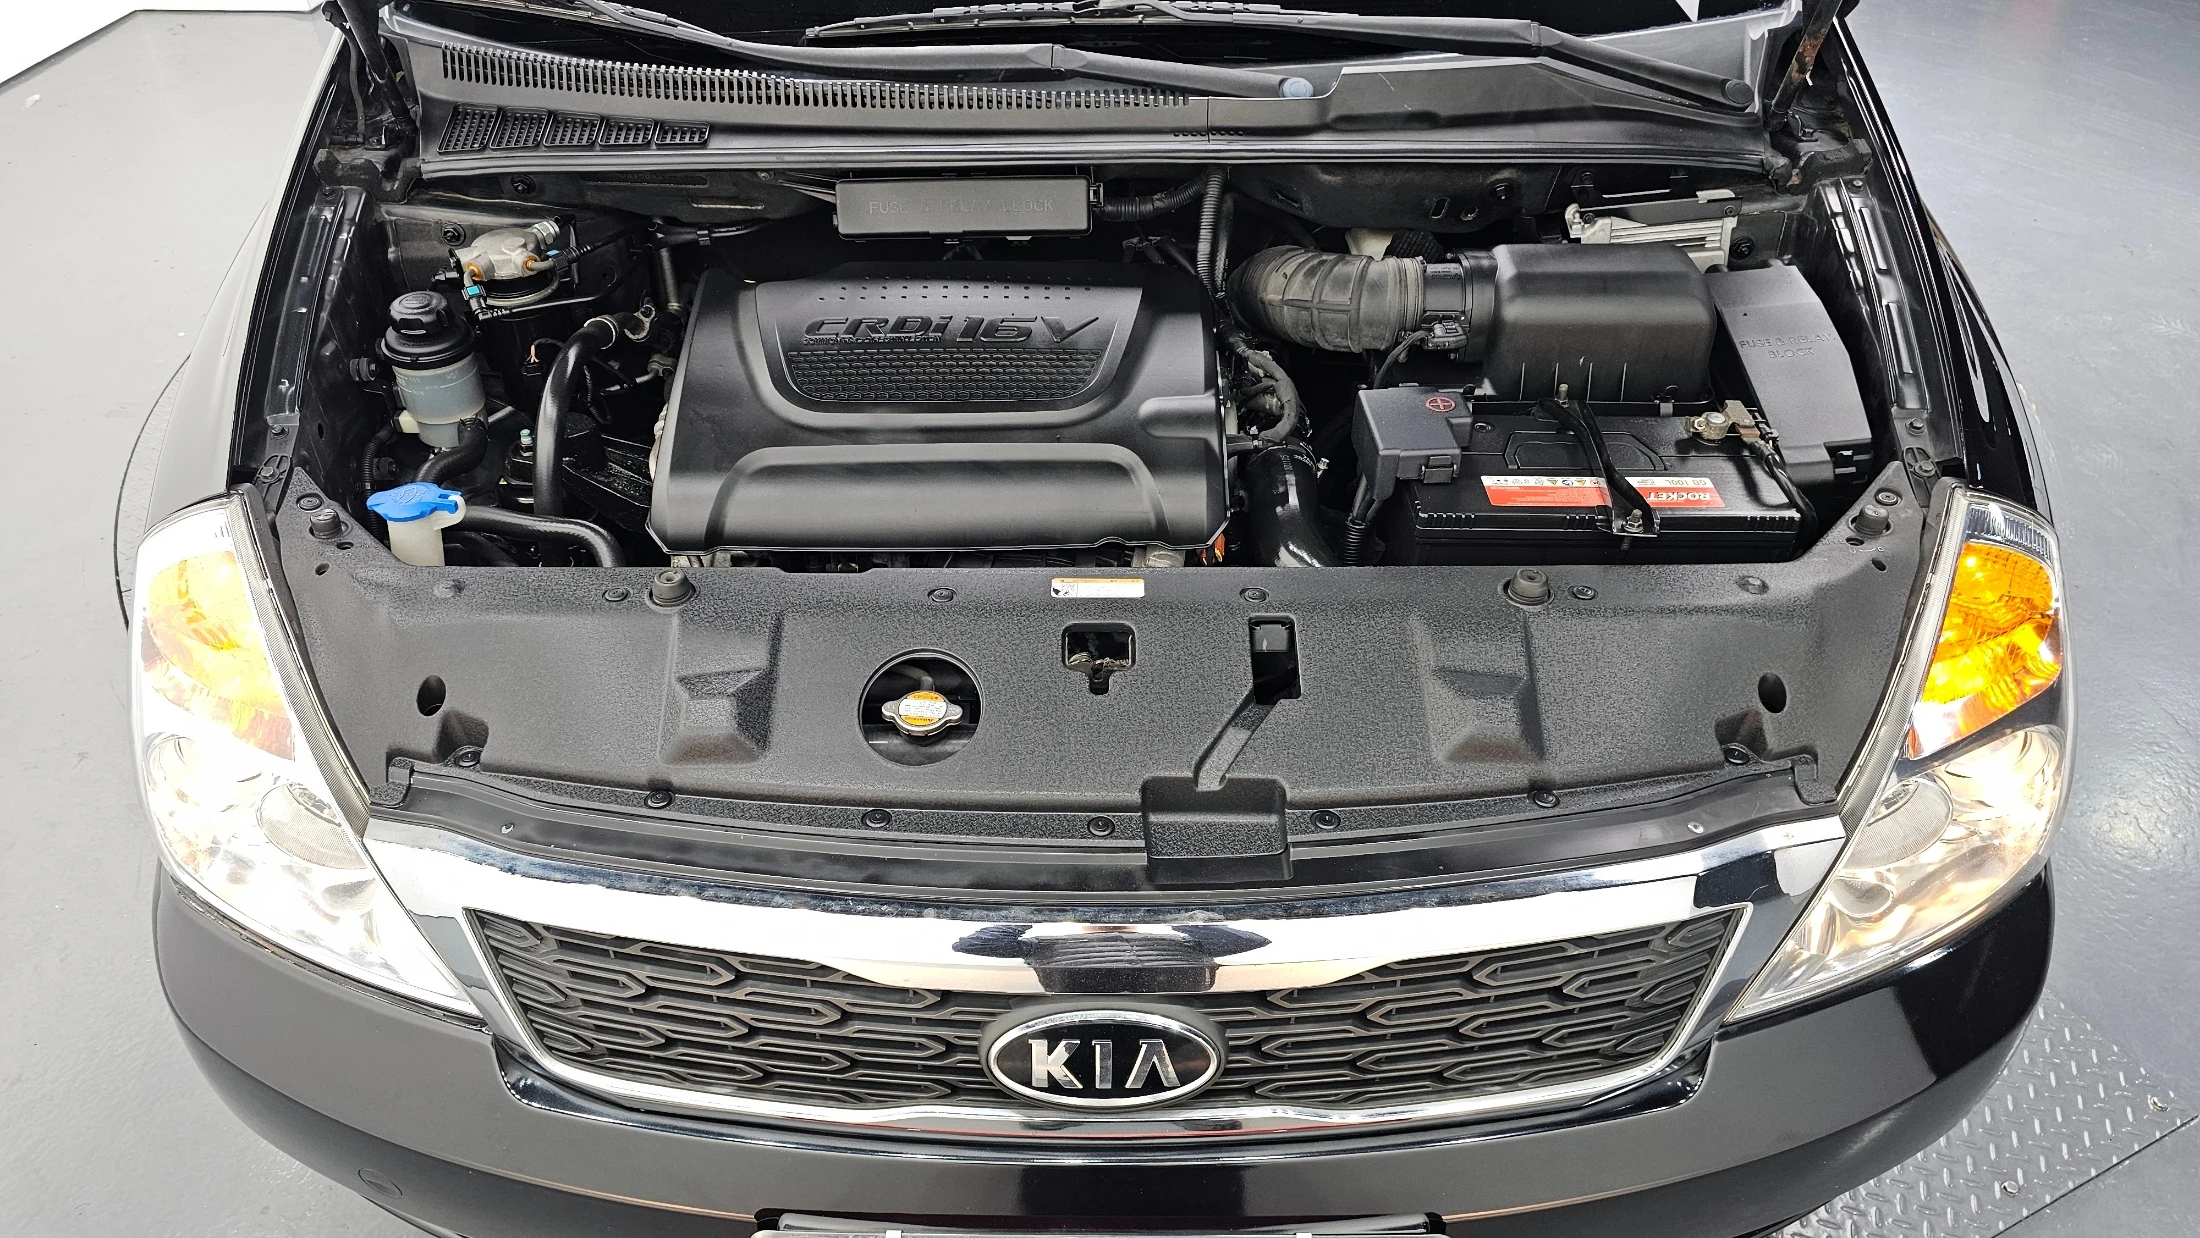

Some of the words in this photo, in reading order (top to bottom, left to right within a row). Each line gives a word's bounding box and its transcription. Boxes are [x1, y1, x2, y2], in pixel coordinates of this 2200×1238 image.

[869, 201, 909, 214] FUSE
[1003, 199, 1054, 212] BLOCK
[803, 315, 953, 339] CRDi
[1739, 338, 1773, 349] FUSE
[1775, 337, 1785, 346] &
[1788, 333, 1831, 345] RELAY
[1768, 347, 1814, 359] BLOCK
[1646, 491, 1711, 501] ROCKET
[1028, 1039, 1181, 1089] KIA
